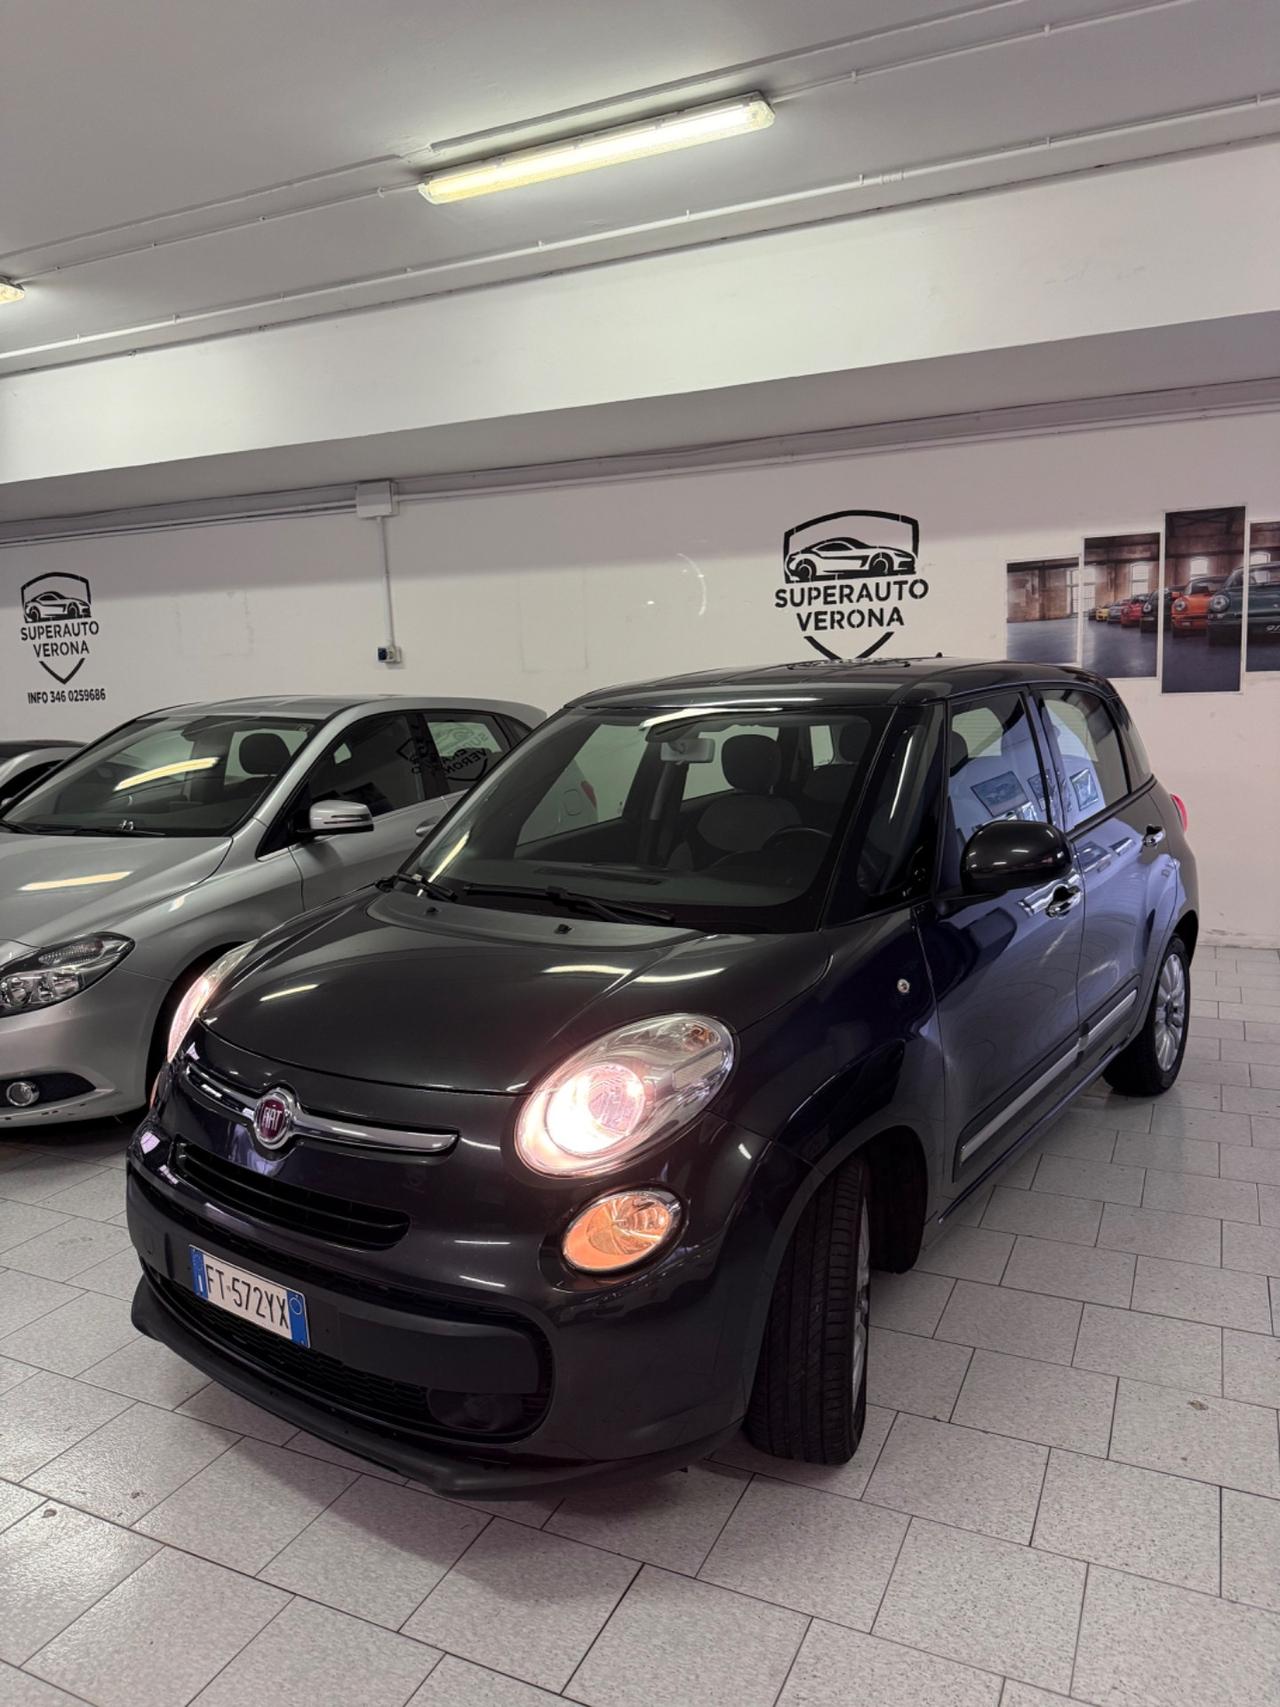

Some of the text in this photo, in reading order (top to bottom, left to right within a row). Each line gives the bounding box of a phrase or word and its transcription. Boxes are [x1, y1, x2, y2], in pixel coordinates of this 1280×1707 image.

[775, 579, 929, 608] SUPERAUTO
[796, 606, 904, 632] VERONA
[20, 621, 99, 641] SUPERAUTO
[33, 640, 89, 658] VERONA
[27, 688, 106, 705] INFO 346 0259686
[262, 1107, 283, 1131] FIAT
